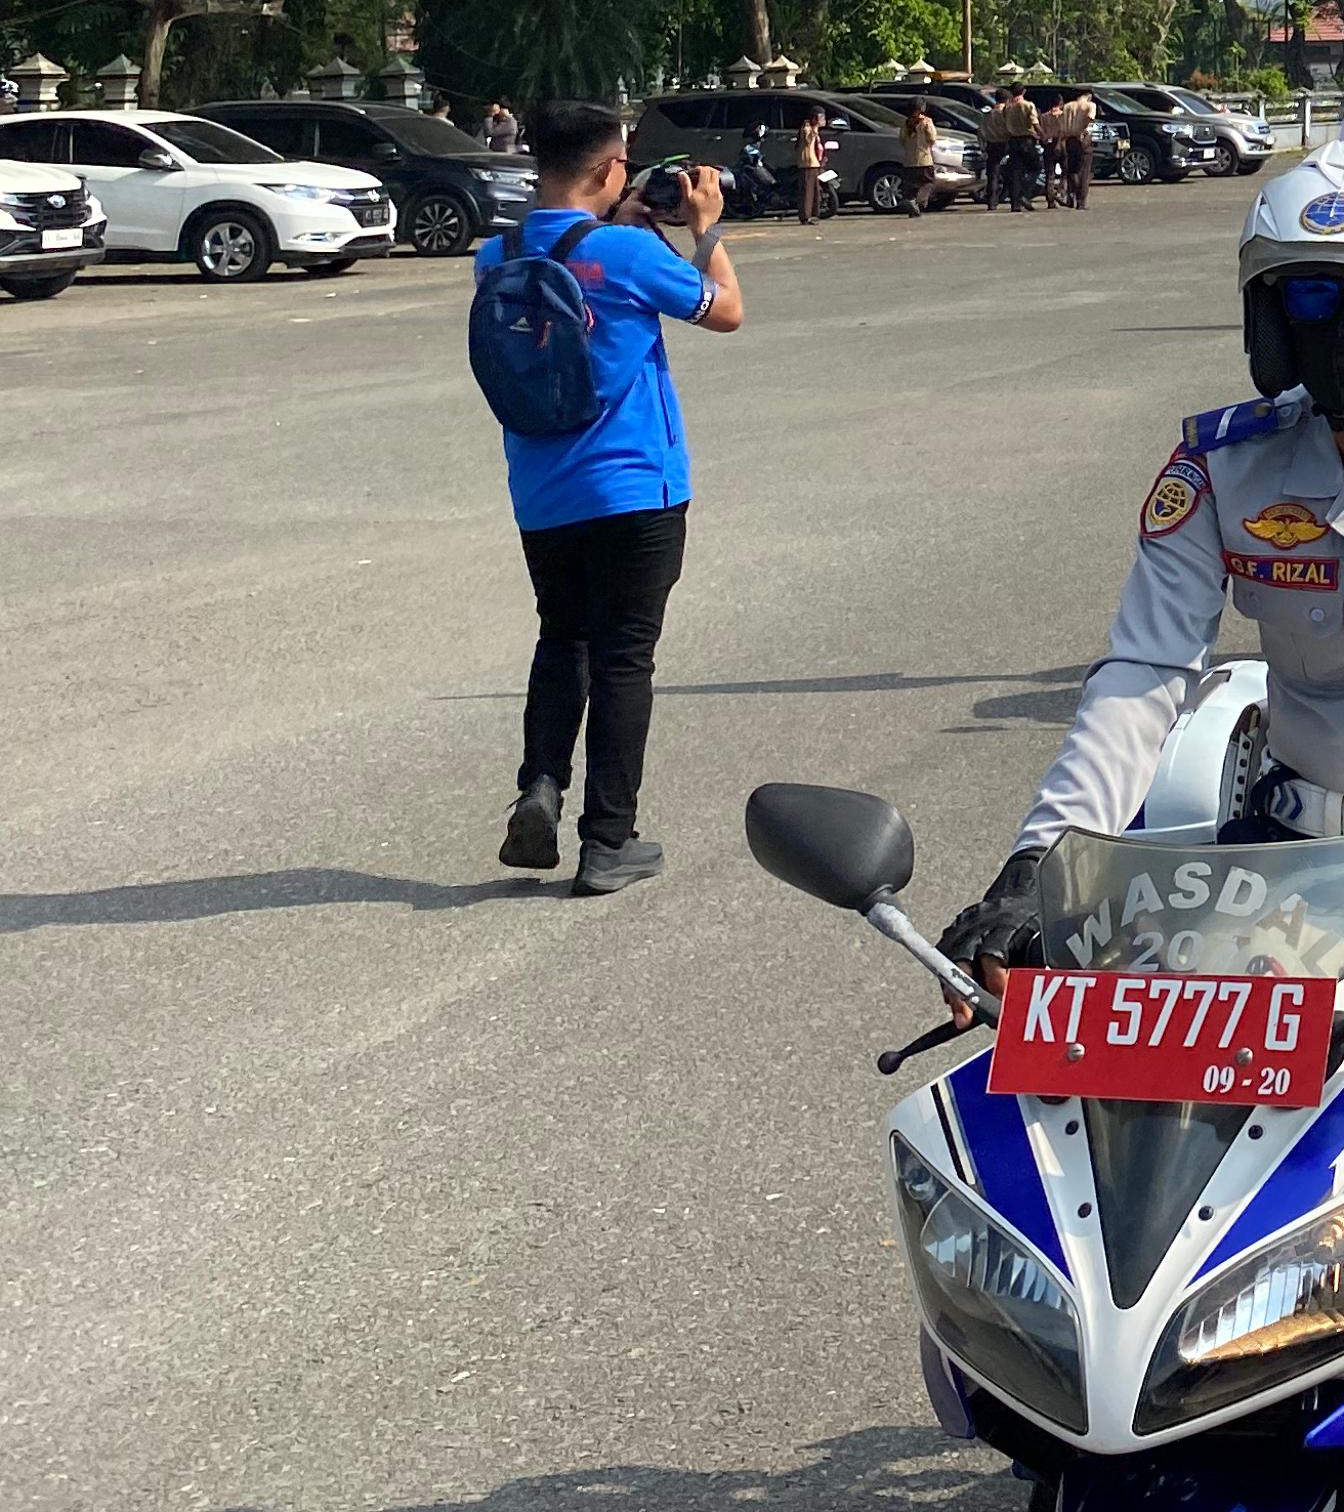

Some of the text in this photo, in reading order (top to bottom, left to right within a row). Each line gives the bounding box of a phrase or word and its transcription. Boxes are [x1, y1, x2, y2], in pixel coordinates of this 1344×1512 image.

[1272, 561, 1331, 584] RIZAL
[1066, 862, 1335, 976] WASDAL
[1023, 975, 1305, 1051] KT 5777 G
